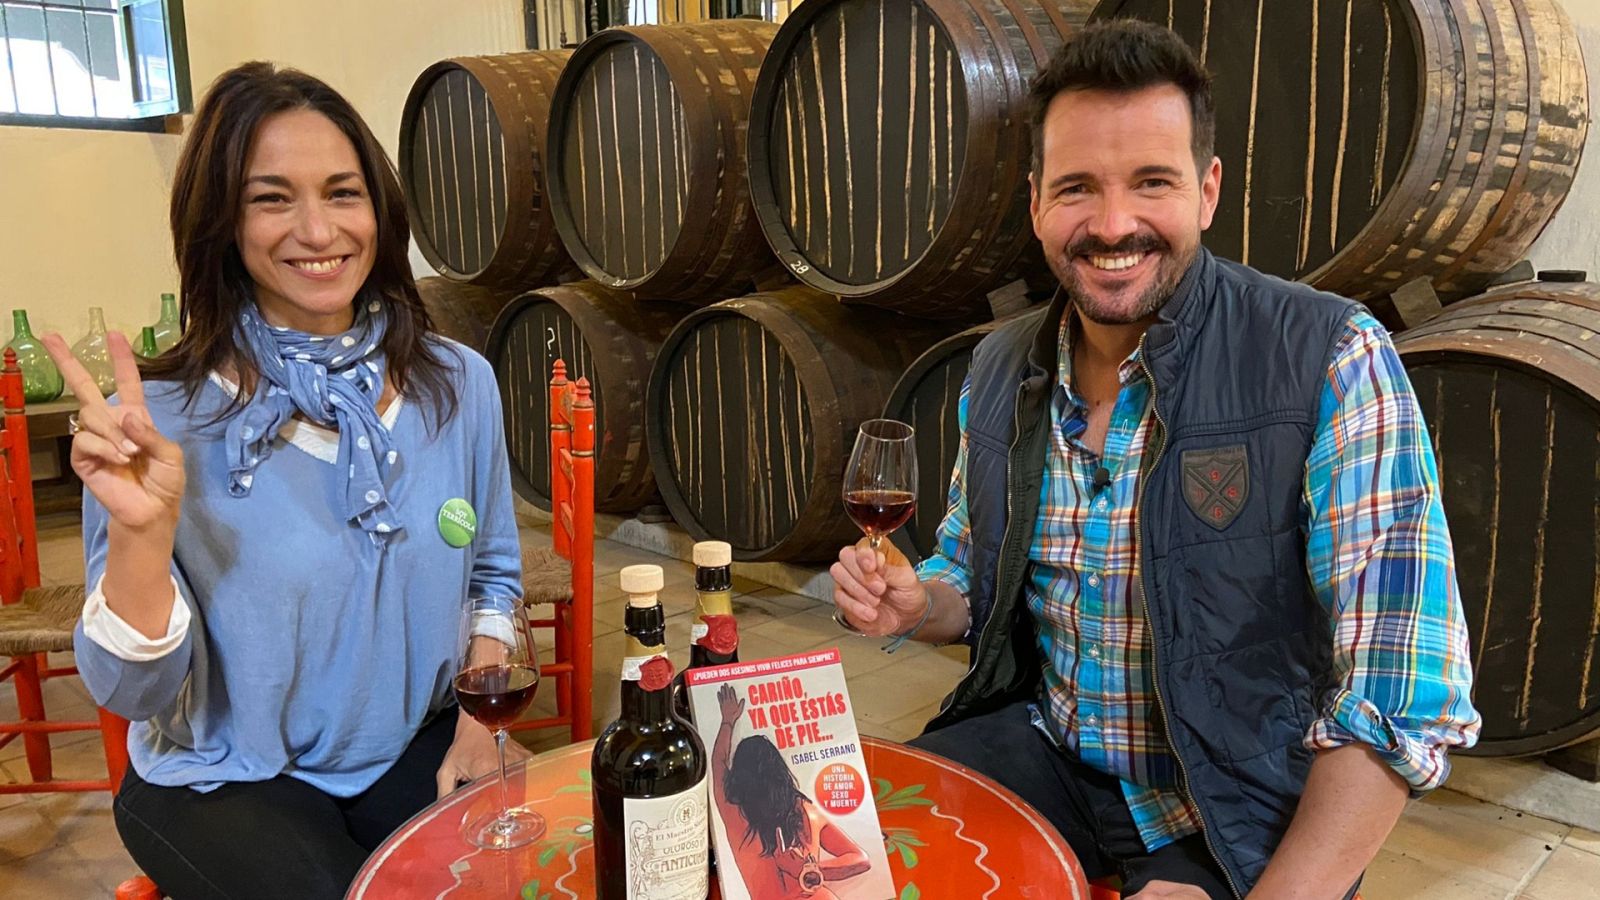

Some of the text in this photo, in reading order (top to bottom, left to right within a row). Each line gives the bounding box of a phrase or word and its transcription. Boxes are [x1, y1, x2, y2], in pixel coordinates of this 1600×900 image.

[693, 652, 835, 681] ¿PUEDEN DOS ASESINOS VIVIR FELICES PARA SIEMPRE?
[747, 676, 808, 705] CARIÑO,
[747, 692, 847, 729] YA QUE ESTÁS
[775, 722, 834, 749] DE PIE...
[791, 743, 857, 765] ISABEL SERRANO
[823, 773, 855, 782] HISTORIA
[831, 765, 846, 774] UNA
[823, 782, 833, 791] DE
[831, 791, 849, 799] SEXO
[824, 799, 858, 808] Y MUERTE
[663, 839, 700, 855] OLOROSO
